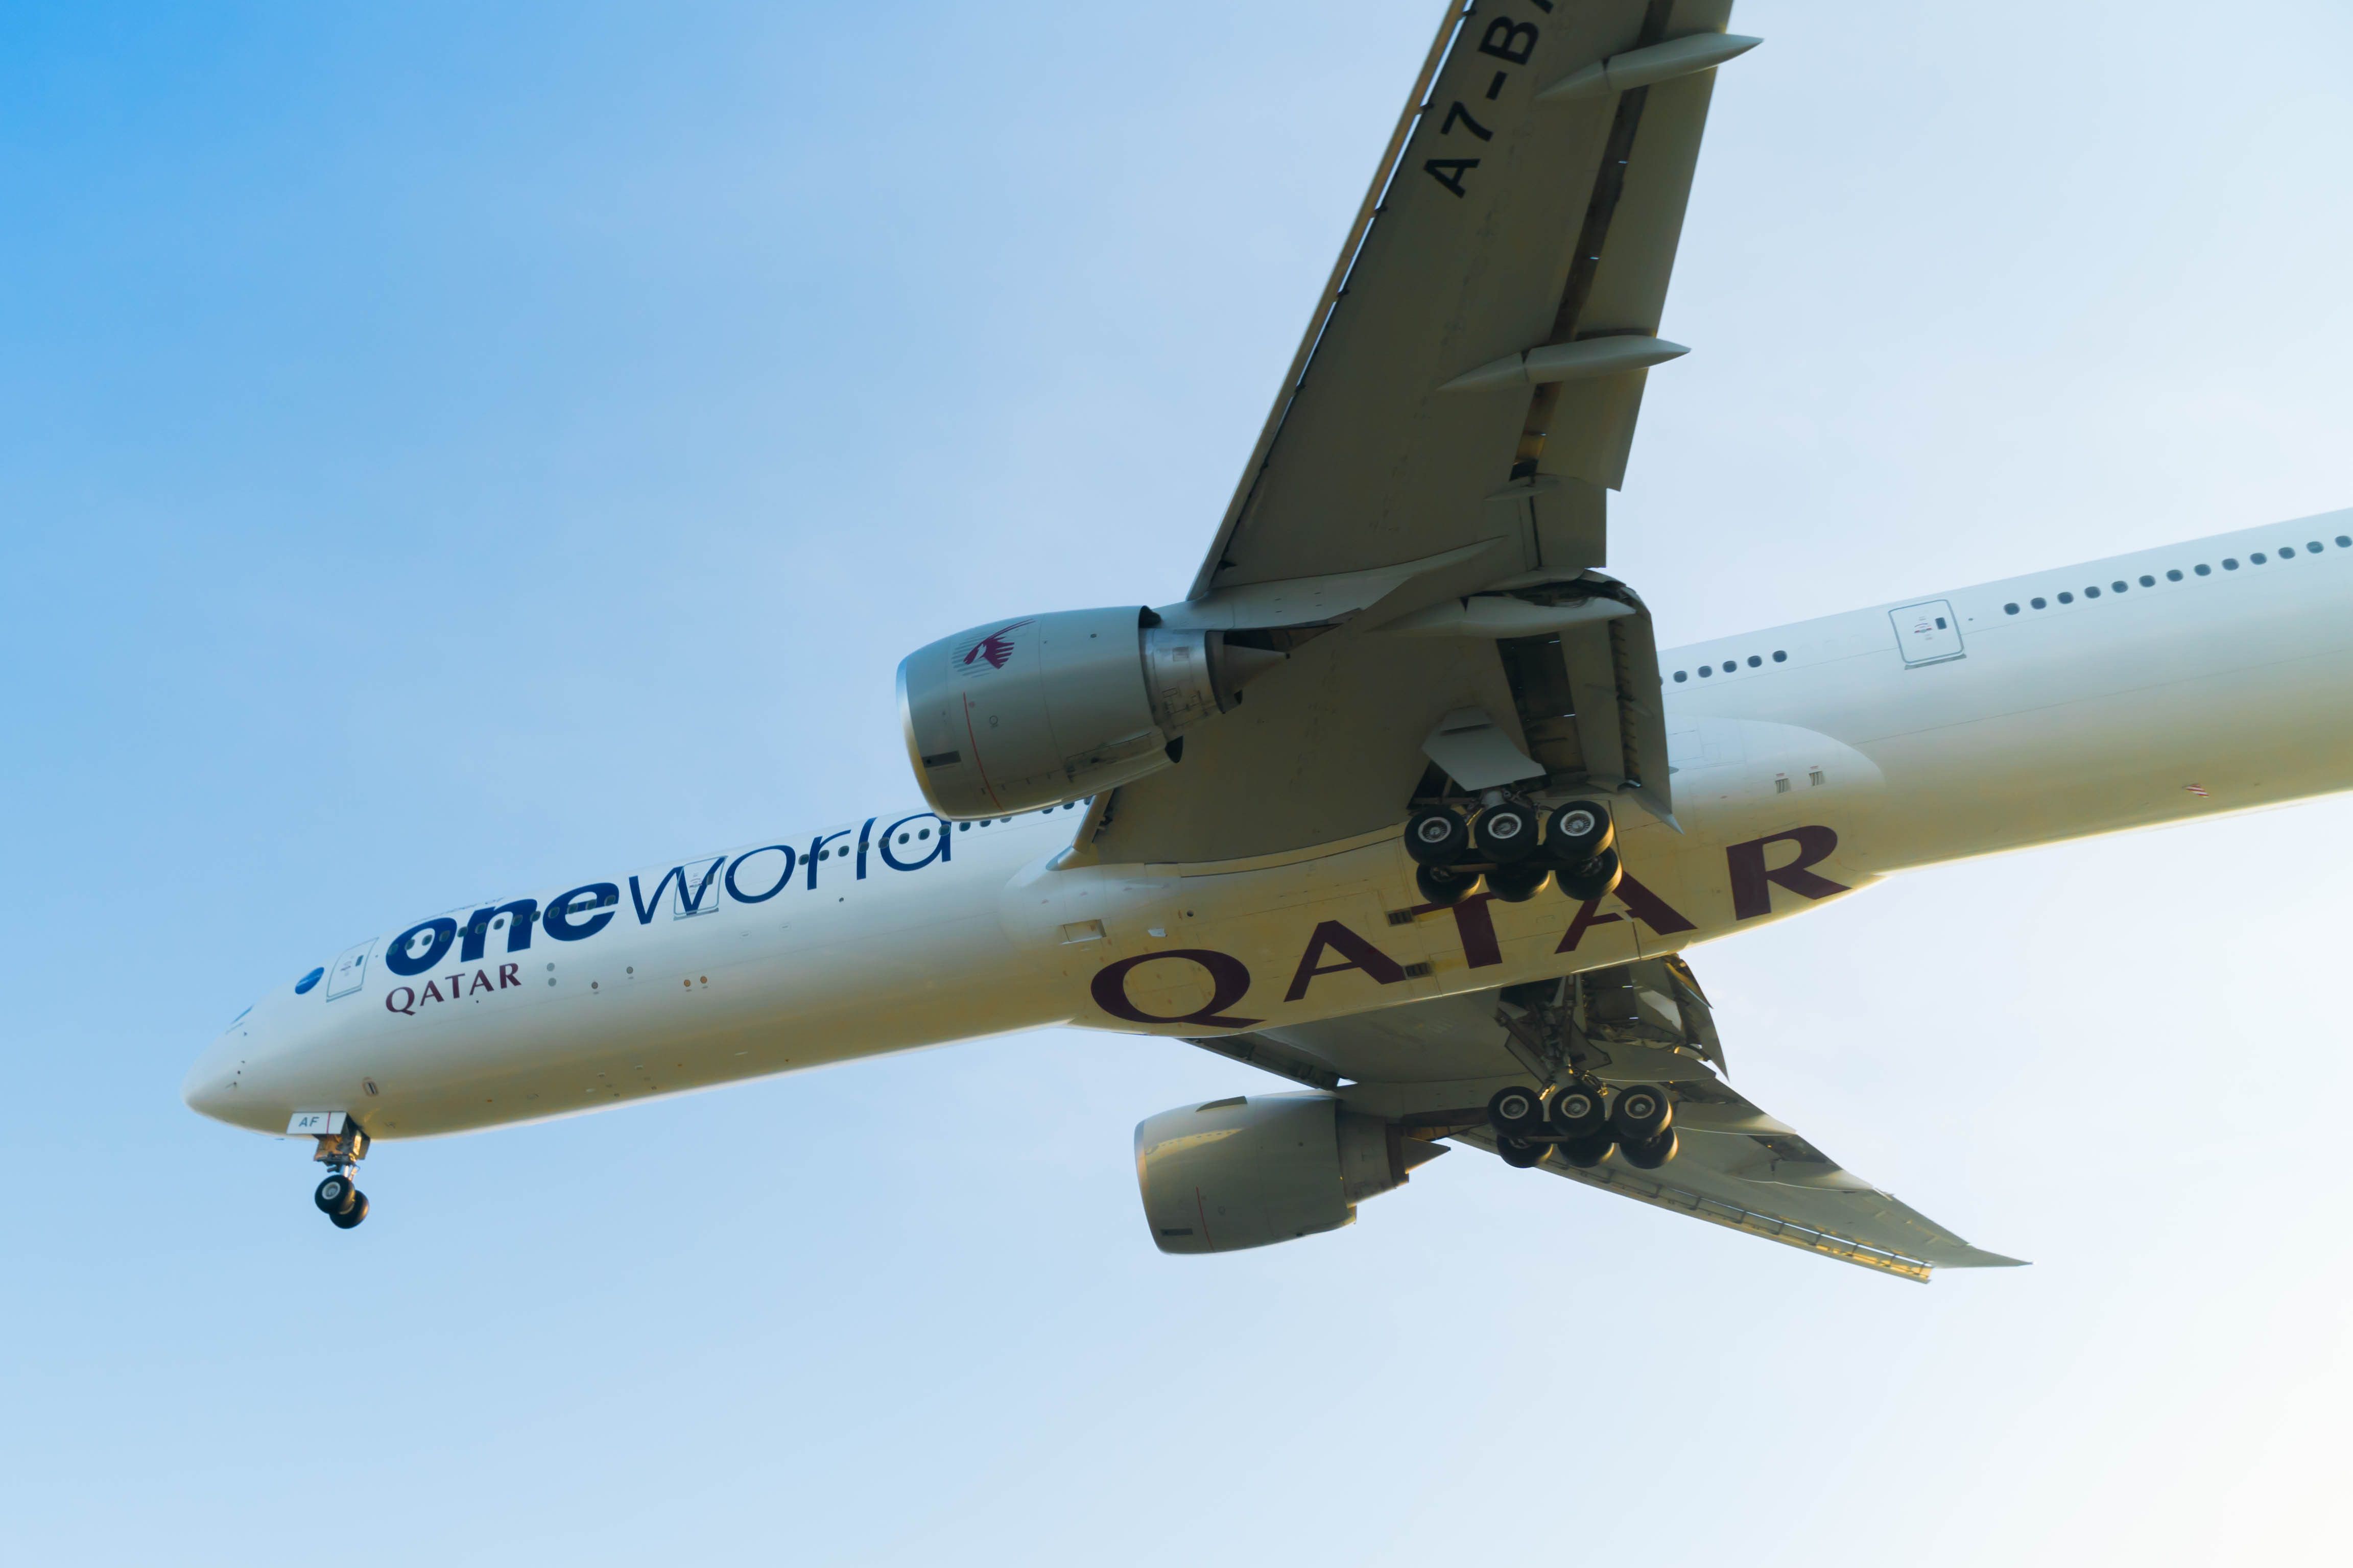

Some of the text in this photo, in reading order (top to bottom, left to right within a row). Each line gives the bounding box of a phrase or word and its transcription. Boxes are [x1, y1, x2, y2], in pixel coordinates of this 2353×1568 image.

[1423, 0, 1553, 199] A7-B
[385, 962, 522, 1016] QATAR
[1090, 824, 1853, 1029] QATAR
[298, 1116, 320, 1127] AF
